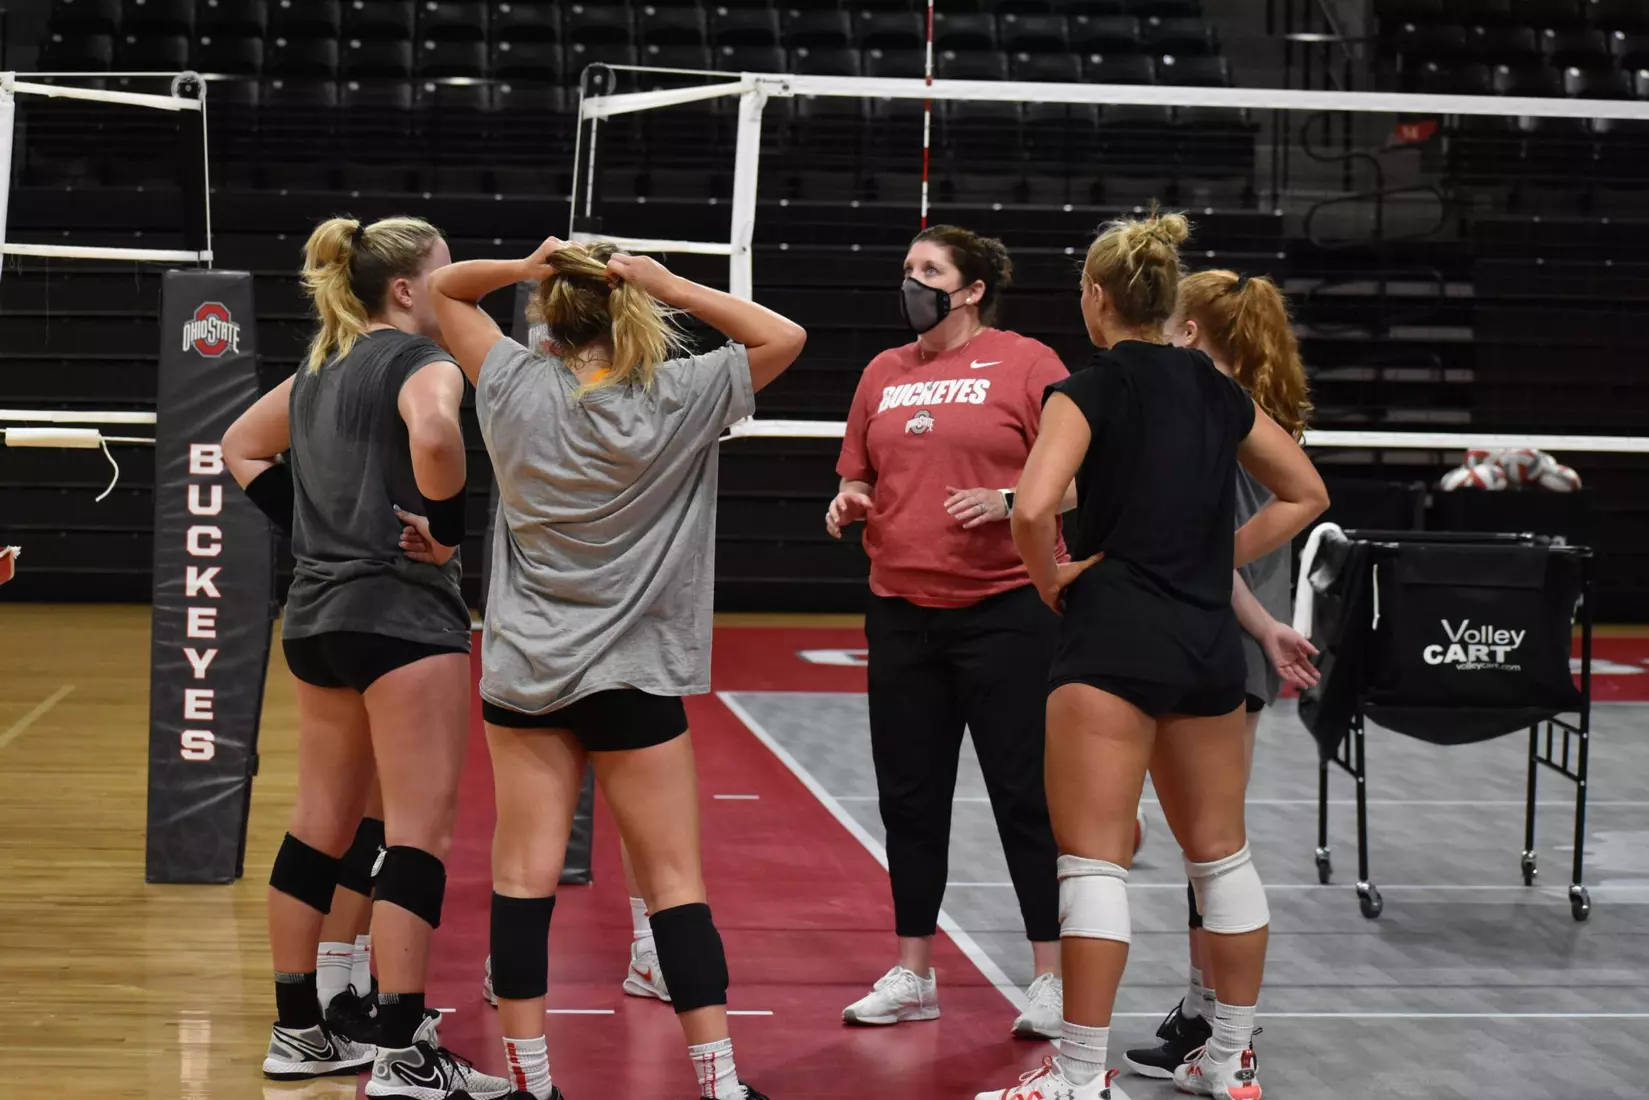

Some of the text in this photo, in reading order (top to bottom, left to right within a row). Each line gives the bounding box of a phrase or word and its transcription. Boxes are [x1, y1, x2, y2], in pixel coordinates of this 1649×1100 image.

[877, 378, 991, 414] BUCKEYES
[180, 442, 224, 761] BUCKEYES
[1440, 618, 1526, 649] Volley
[1423, 643, 1512, 665] CART
[1455, 660, 1521, 672] volleycart.com
